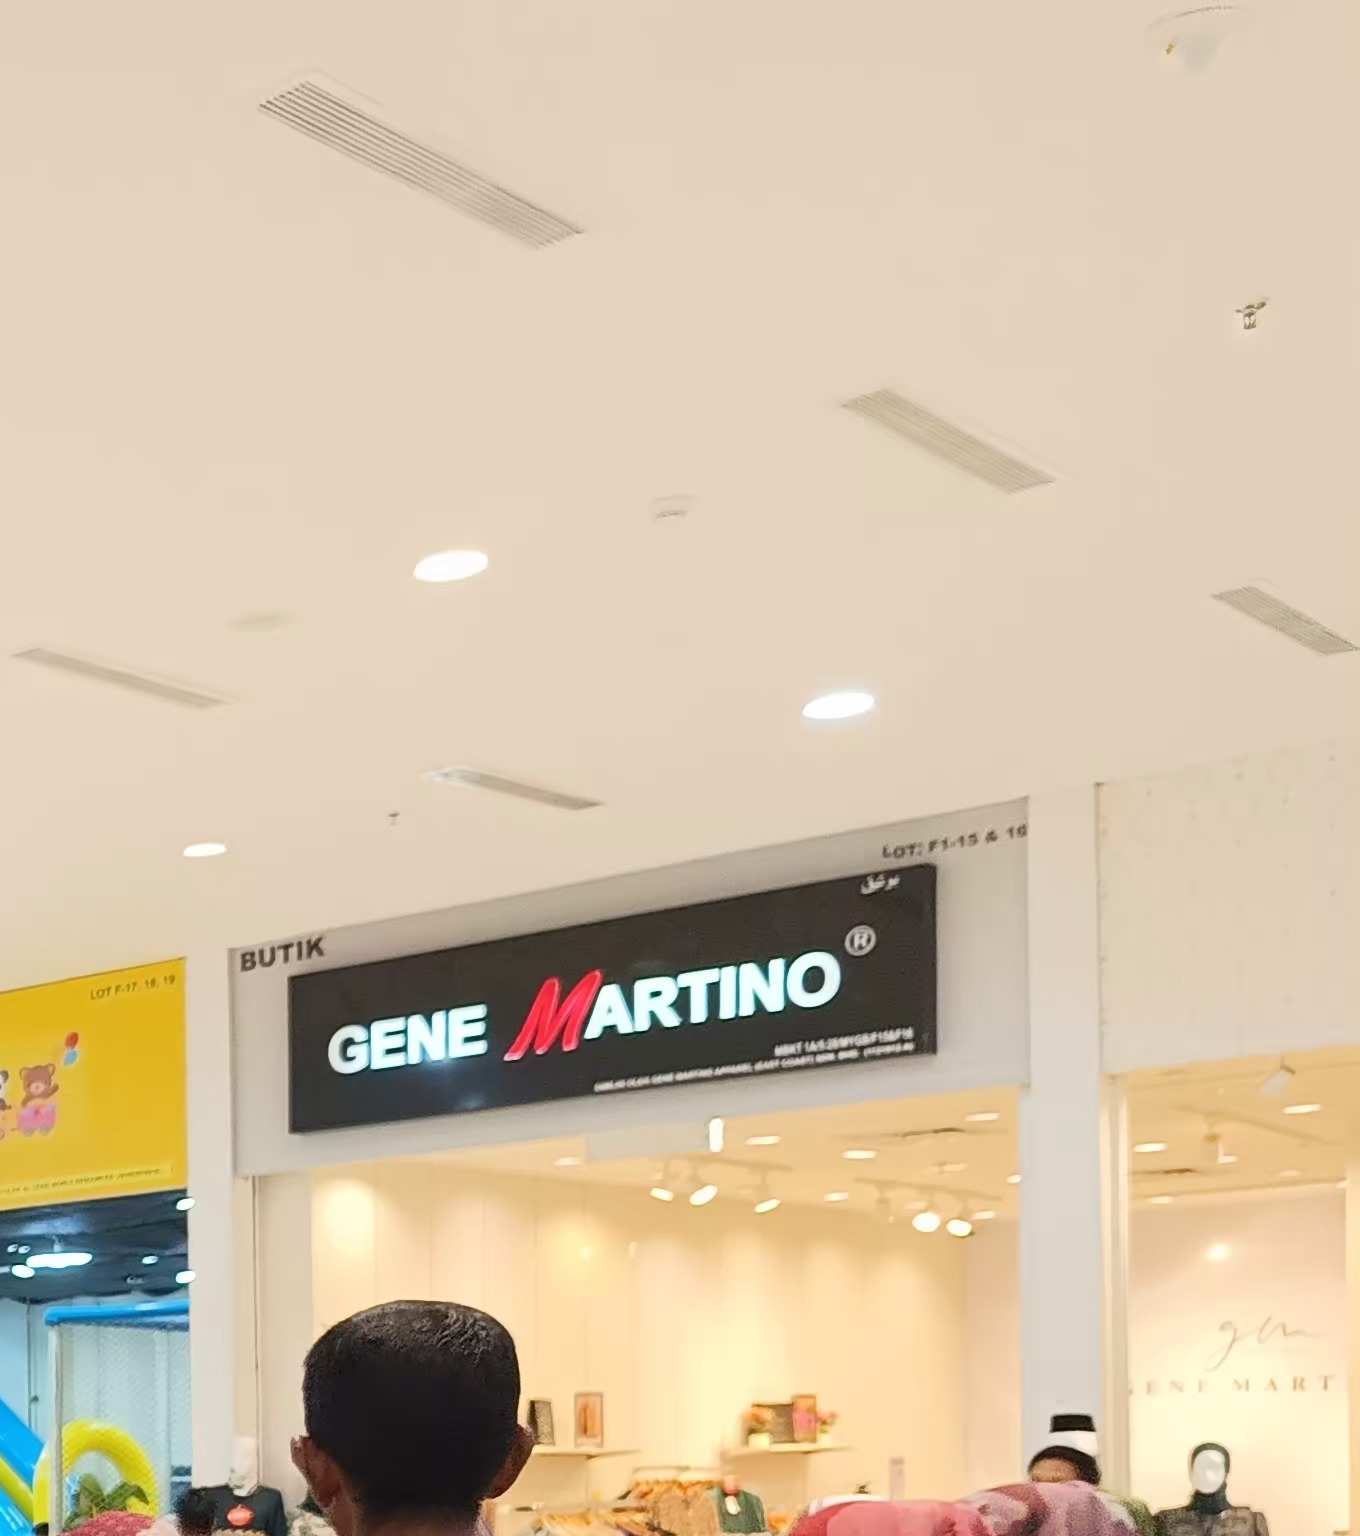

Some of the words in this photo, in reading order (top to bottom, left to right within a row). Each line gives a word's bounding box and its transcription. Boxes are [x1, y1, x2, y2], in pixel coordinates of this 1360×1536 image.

[240, 936, 325, 972] BUTIK
[327, 1003, 488, 1074] GENE
[503, 950, 843, 1061] MARTINO
